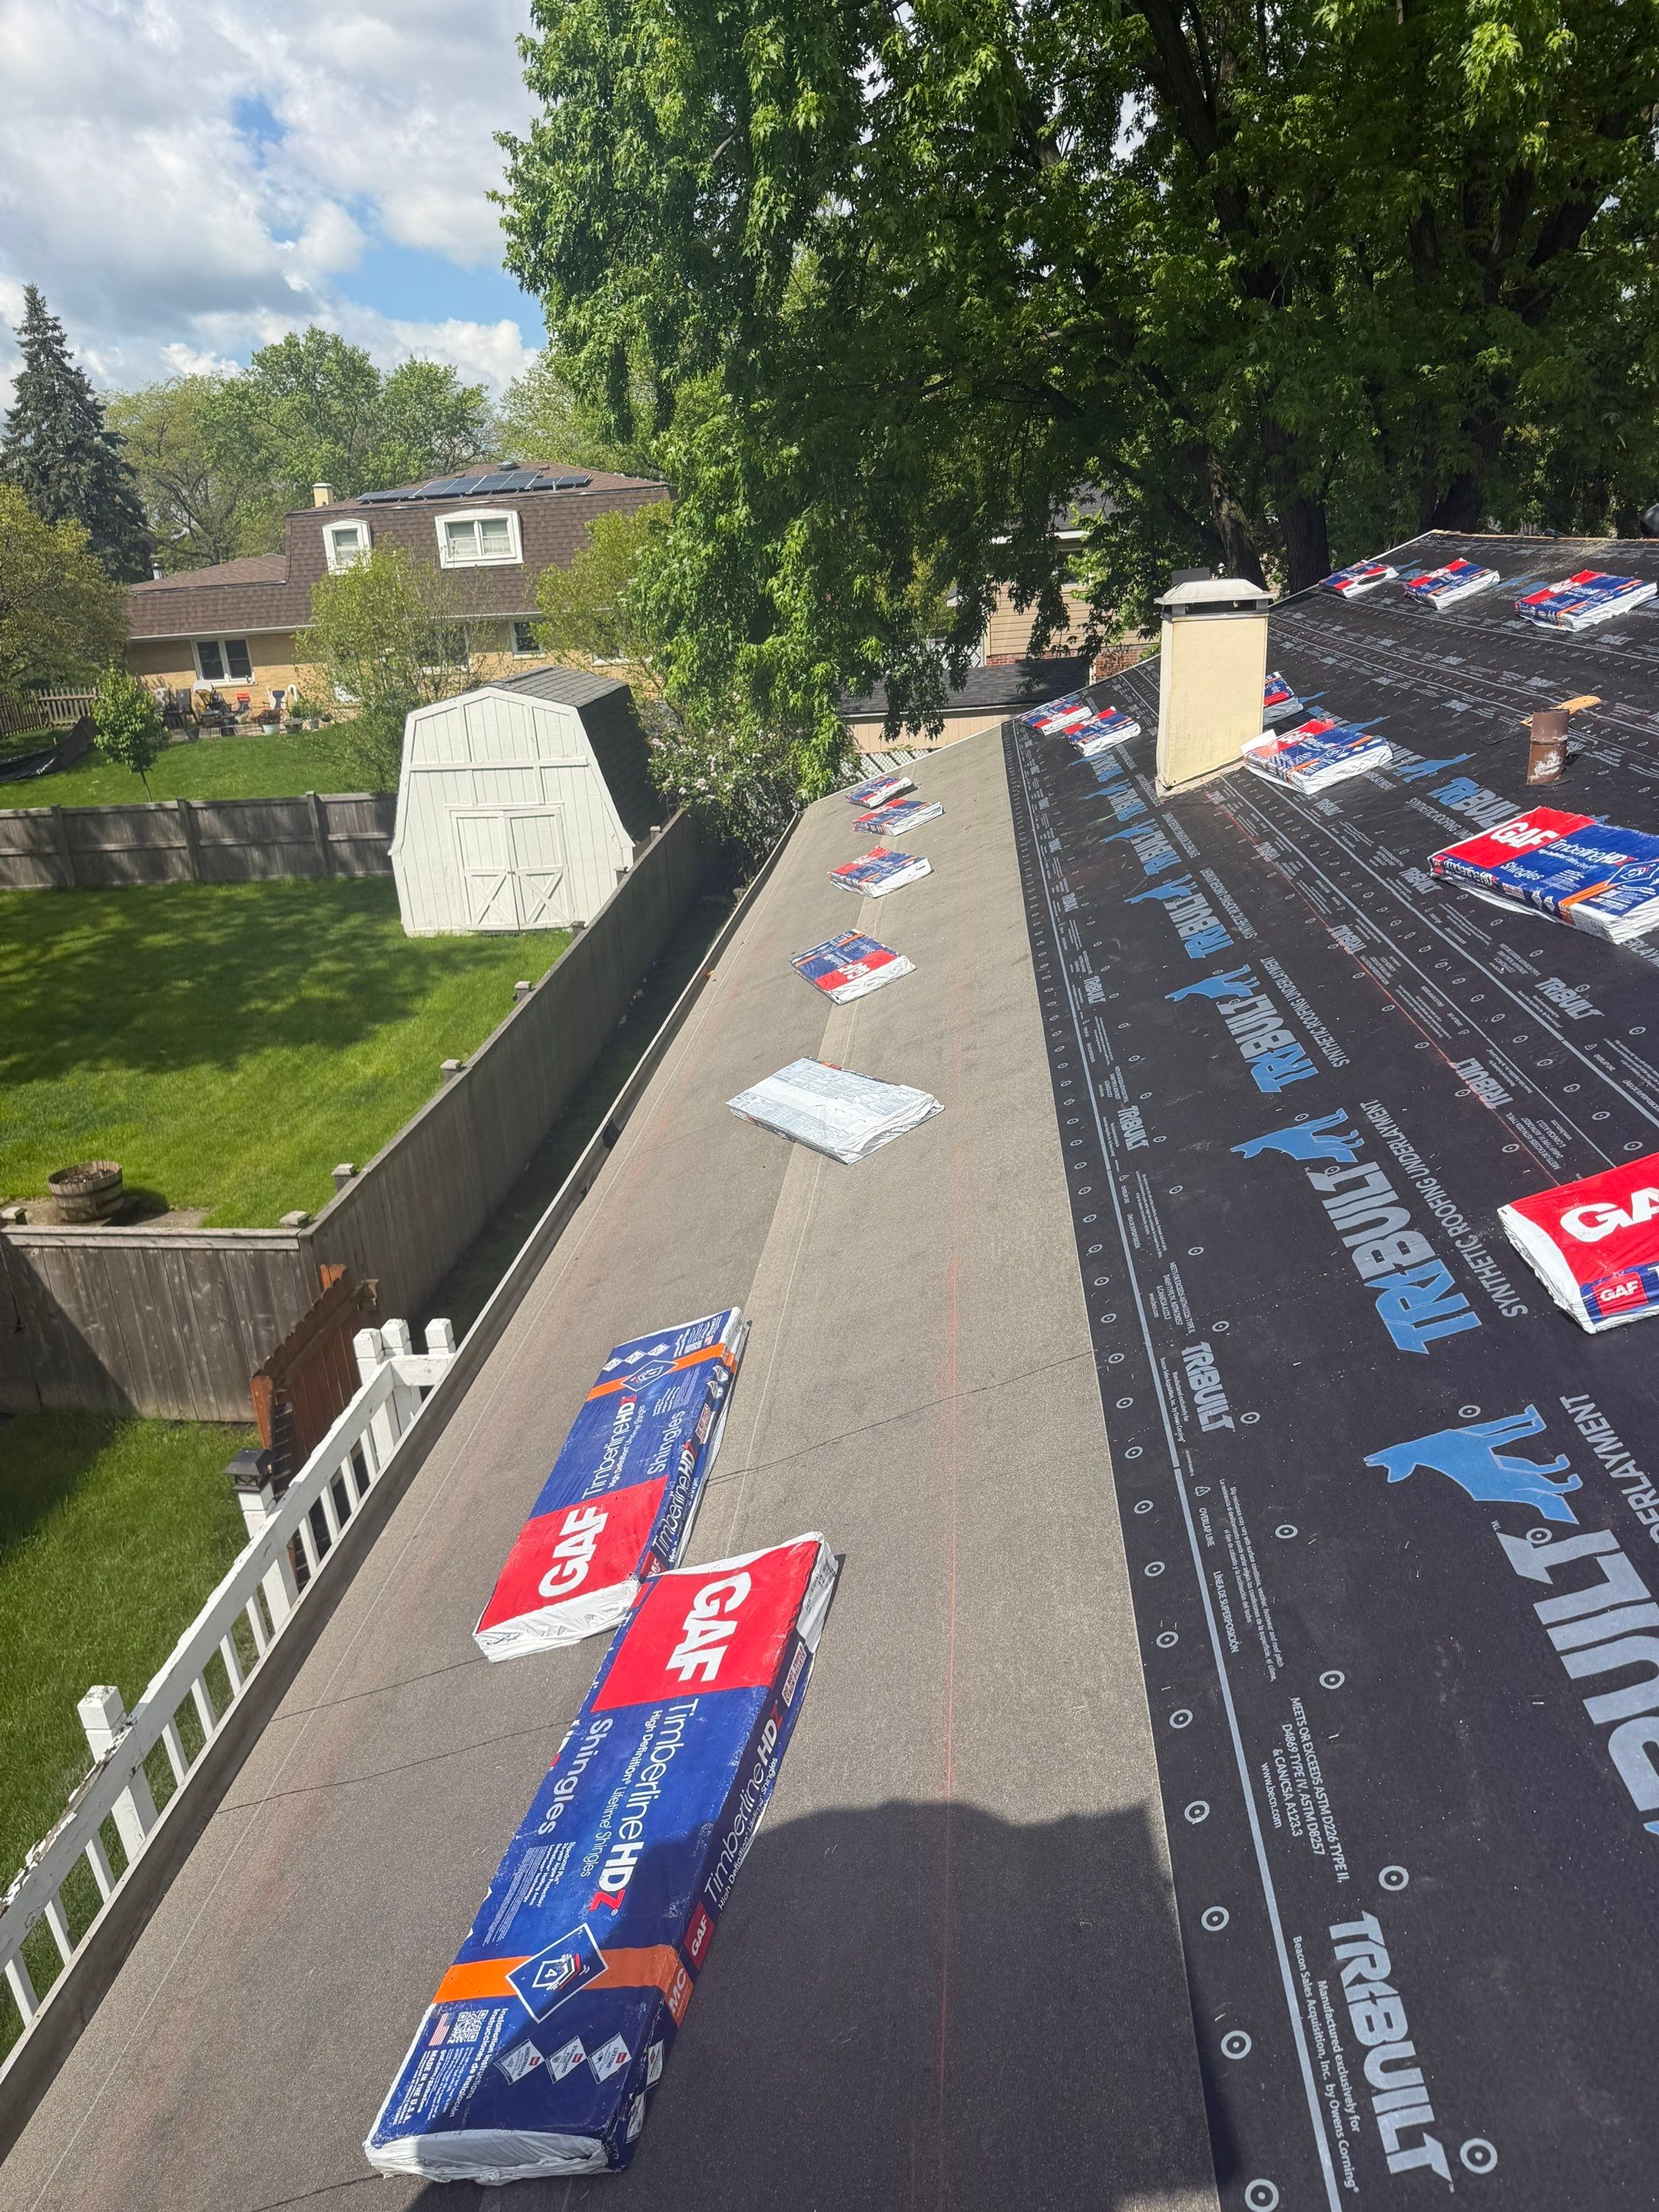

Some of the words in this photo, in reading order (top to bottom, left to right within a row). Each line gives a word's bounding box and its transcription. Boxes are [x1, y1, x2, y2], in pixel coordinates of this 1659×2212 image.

[1426, 775, 1522, 830] TRIBUIL
[1492, 820, 1561, 849] GAF
[1260, 955, 1302, 1000] UNDERLAYMENT
[1534, 974, 1605, 1020] TRIBUILT
[1290, 997, 1323, 1029] ROOFING
[1308, 1025, 1351, 1068] SYNTHETIC
[1446, 1057, 1514, 1111] TRIBUILT
[1117, 1104, 1149, 1151] TRIBUILT
[1359, 1097, 1431, 1178] UNDERLAYMENT
[1413, 1175, 1471, 1237] ROOFING
[1168, 1261, 1178, 1275] MEETS
[1305, 1158, 1482, 1354] TRIBUILT
[1452, 1232, 1529, 1319] SYNTHETIC
[1166, 1286, 1175, 1296] TYPE
[1171, 1302, 1180, 1314] ASTM
[1174, 1281, 1185, 1298] EXCEEDS
[1600, 1280, 1638, 1302] GAF
[1179, 1298, 1188, 1310] ASTM
[1185, 1320, 1194, 1330] TYPE
[1159, 1356, 1168, 1373] Beacon
[1162, 1372, 1171, 1383] Sales
[1171, 1371, 1183, 1396] Manufactured
[1177, 1396, 1188, 1416] exclusively
[1181, 1341, 1235, 1432] TRIBUILT
[1172, 1416, 1182, 1429] Owens
[646, 1408, 686, 1474] Shingles
[1220, 1484, 1232, 1507] resistencia
[1229, 1485, 1237, 1495] Slip
[1197, 1506, 1212, 1533] OVERLAP
[1231, 1495, 1243, 1518] resistance
[1227, 1511, 1240, 1540] deslizamiento
[1237, 1517, 1247, 1528] may
[1240, 1528, 1250, 1538] vary
[538, 1505, 610, 1598] GAF
[1204, 1533, 1215, 1547] LINE
[1233, 1539, 1244, 1554] puede
[1243, 1538, 1252, 1548] with
[1237, 1553, 1248, 1570] variar
[1245, 1548, 1257, 1566] surface
[1211, 1569, 1227, 1593] LÍNEA
[1241, 1570, 1251, 1582] según
[1244, 1581, 1253, 1590] las
[1250, 1565, 1263, 1591] conditions,
[1217, 1592, 1230, 1603] DE
[1247, 1589, 1260, 1618] condiciones
[1257, 1590, 1269, 1611] weather,
[665, 1571, 753, 1684] GAF
[1220, 1602, 1243, 1653] SUPERPOSICIÓN
[1262, 1610, 1275, 1633] footwear
[1257, 1631, 1271, 1658] superficie,
[1268, 1632, 1278, 1643] and
[1270, 1643, 1280, 1654] roof
[783, 1684, 789, 1697] DO
[791, 1643, 803, 1669] TRIPLE
[1266, 1664, 1277, 1682] clima,
[1273, 1654, 1284, 1667] pitch
[785, 1680, 795, 1703] STACK
[793, 1650, 806, 1681] PALLETS
[642, 1711, 663, 1734] High
[1290, 1696, 1308, 1730] MEETS
[1270, 1747, 1283, 1757] &
[1281, 1723, 1299, 1754] D4869
[1299, 1730, 1313, 1747] OR
[536, 1719, 614, 1837] Shingles
[758, 1755, 780, 1796] Shingles
[1273, 1757, 1294, 1802] CAN/CSA
[1289, 1754, 1305, 1779] TYPE
[1303, 1747, 1325, 1792] EXCEEDS
[1260, 1762, 1283, 1830] www.becn.com
[1295, 1779, 1309, 1793] IV,
[1284, 1802, 1303, 1837] A123.3
[1299, 1793, 1316, 1823] ASTM
[1315, 1792, 1333, 1821] ASTM
[1306, 1823, 1325, 1856] D8257
[1323, 1821, 1339, 1847] D226
[578, 1834, 611, 1879] Shingles
[1329, 1847, 1346, 1873] TYPE
[1336, 1873, 1349, 1883] II,
[691, 1914, 711, 1957] GAF
[1290, 1935, 1310, 1978] Beacon
[667, 1966, 689, 2013] MC
[1300, 1978, 1317, 2008] Sales
[474, 2008, 500, 2061] Instrucciones
[485, 2008, 508, 2054] Installation
[1306, 2008, 1332, 2072] Acquisition,
[1316, 1979, 1344, 2058] Manufactured
[1333, 2058, 1359, 2116] exclusively
[1347, 2116, 1363, 2134] for
[1329, 1909, 1452, 2183] TRIBUILT
[423, 2050, 438, 2073] MADE
[469, 2062, 478, 2075] de
[412, 2082, 423, 2098] THE
[419, 2073, 428, 2081] IN
[465, 2054, 492, 2100] Instructions
[1320, 2073, 1337, 2095] Inc.
[401, 2098, 418, 2123] U.S.A.
[1326, 2095, 1341, 2111] by
[1329, 2111, 1349, 2147] Owens
